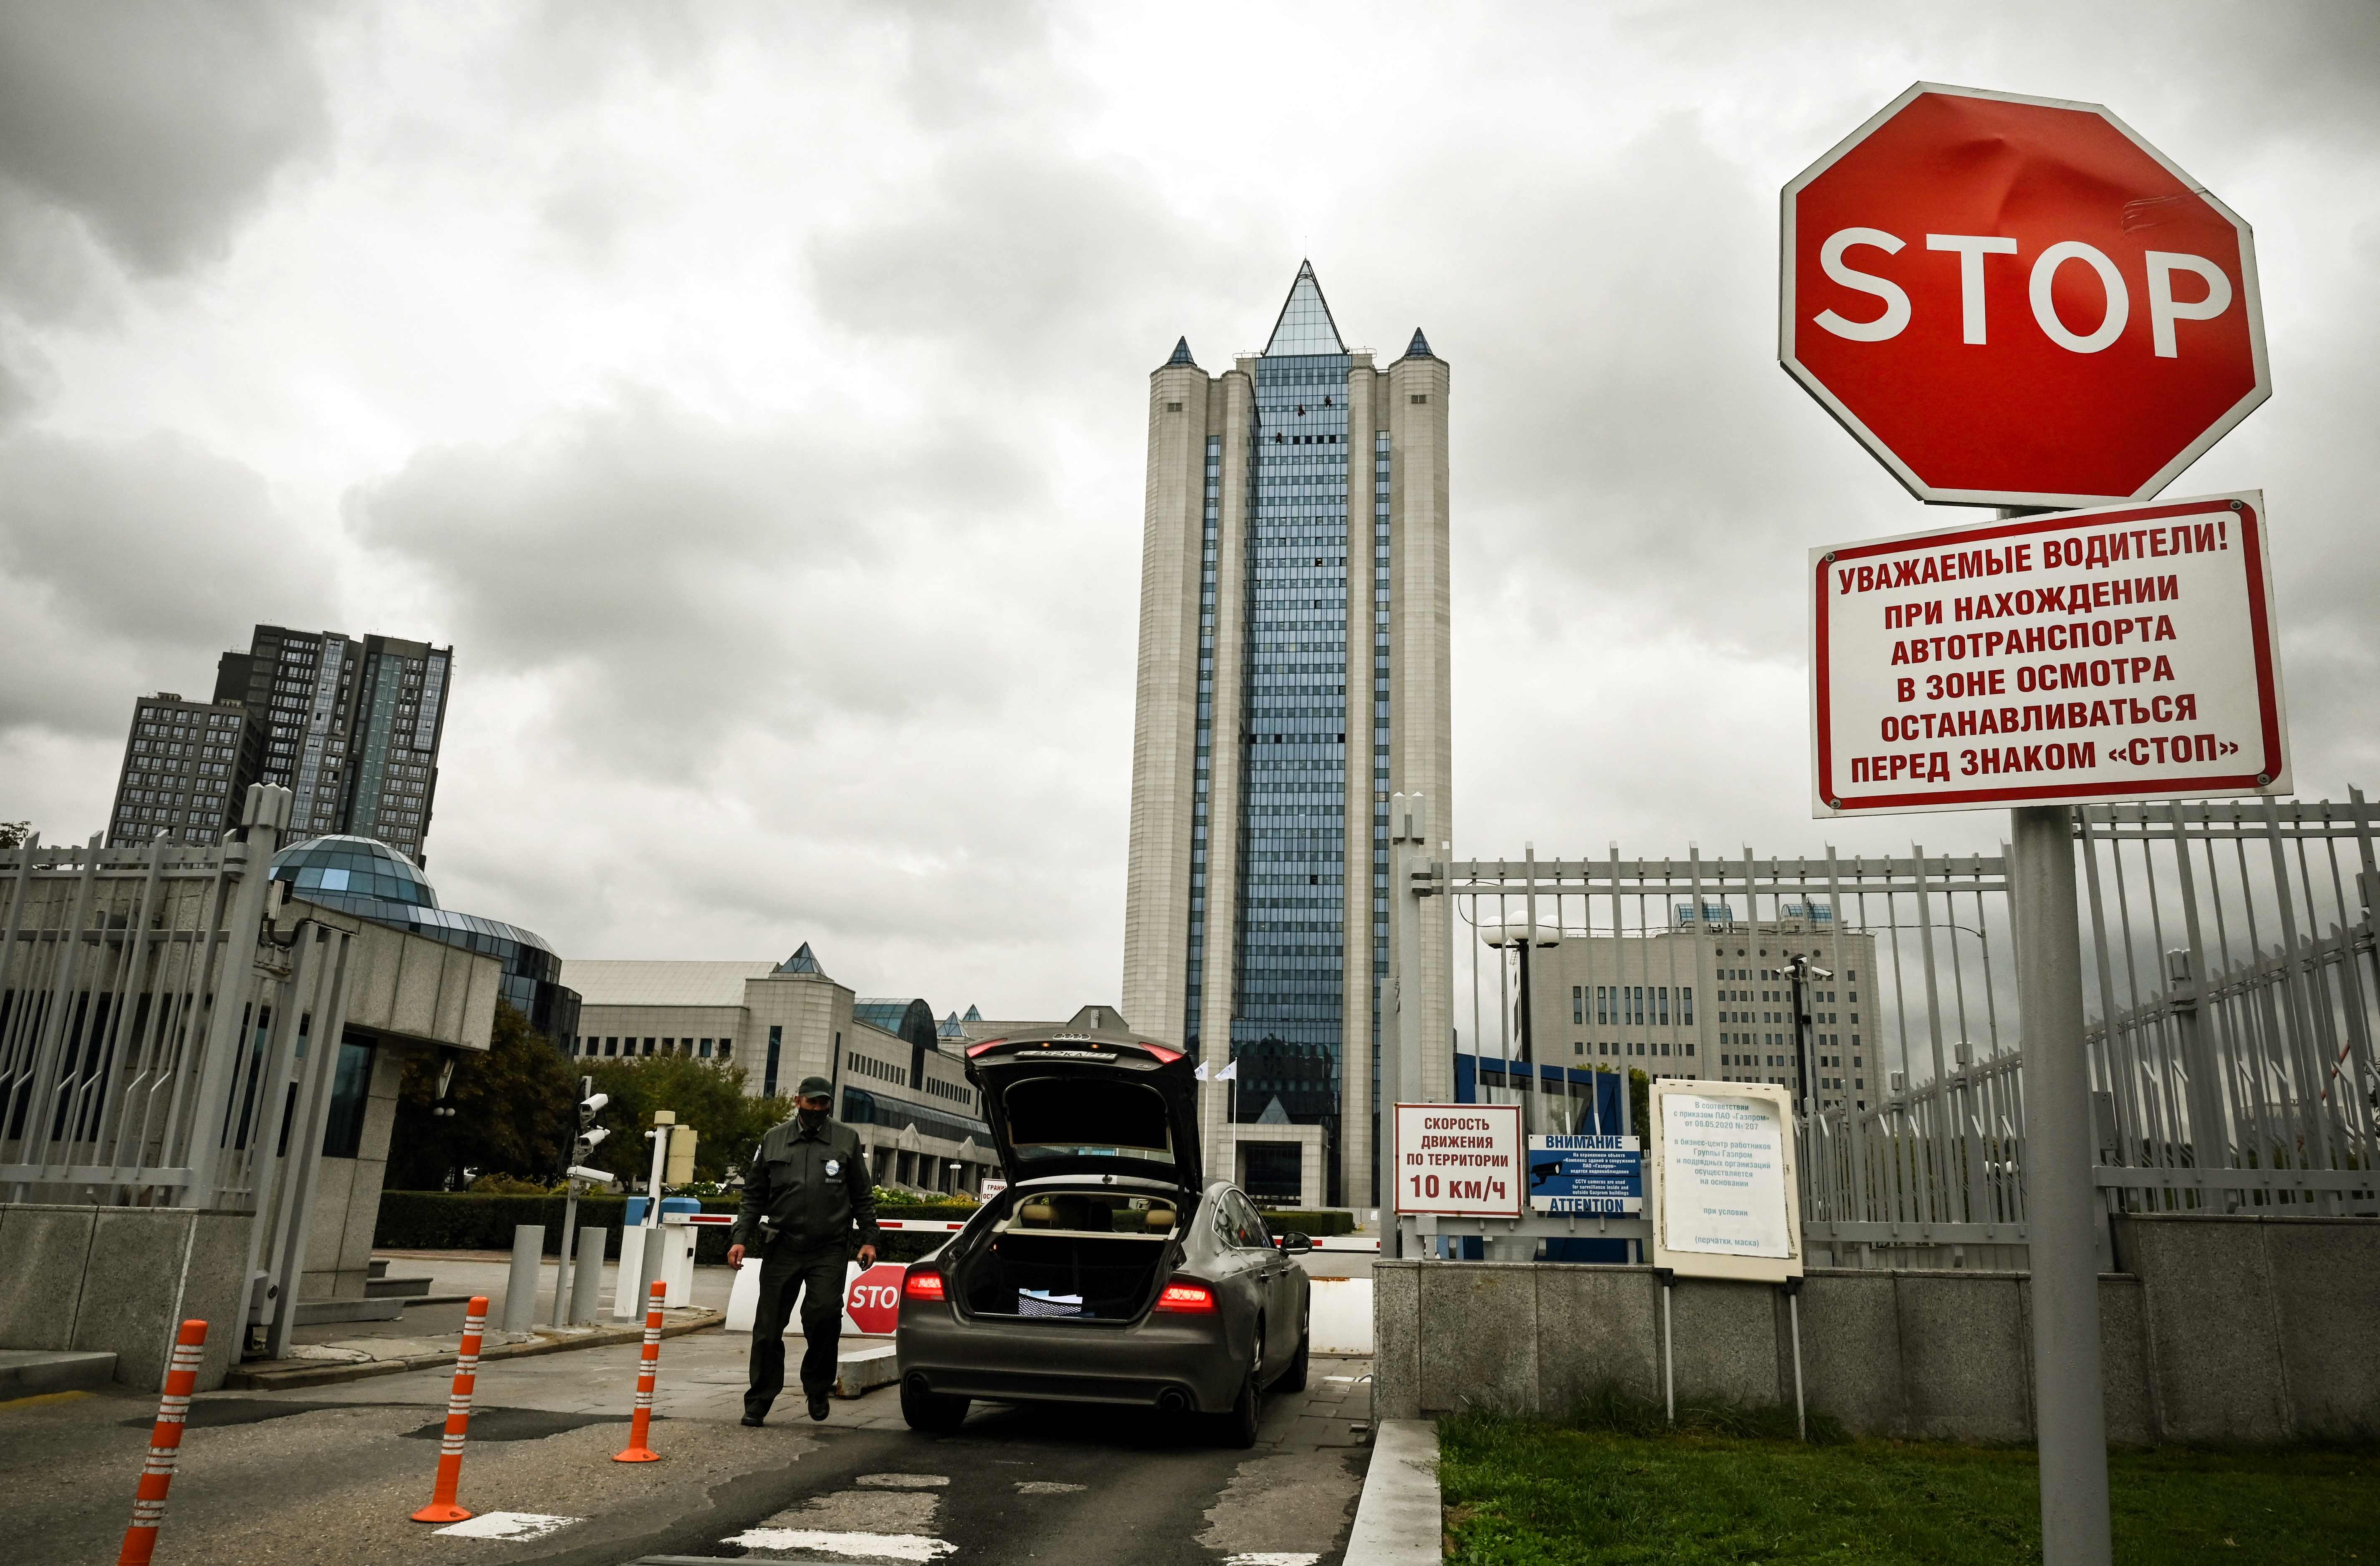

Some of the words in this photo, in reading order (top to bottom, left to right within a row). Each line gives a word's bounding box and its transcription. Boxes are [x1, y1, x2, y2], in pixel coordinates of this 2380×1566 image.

[1813, 227, 2232, 359] STOP
[1838, 543, 2032, 594] УВАЖАЕМЫЕ
[2044, 522, 2227, 569] ВОДИТЕЛИ!
[1885, 598, 1942, 630] ПРИ
[1955, 574, 2179, 622] НАХОЖДЕНИИ
[1891, 614, 2176, 666] АВТОТРАНСПОРТА
[1898, 677, 1915, 702] В
[1926, 669, 2004, 701] ЗОНЕ
[2017, 655, 2175, 694] ОСМОТРА
[1881, 693, 2197, 743] ОСТАНАВЛИВАТЬСЯ
[1852, 750, 1950, 783] ПЕРЕД
[1961, 742, 2096, 775] ЗНАКОМ
[2108, 733, 2239, 766] «СТОП»
[1424, 1117, 1490, 1130] СКОРОСТЬ
[1732, 1113, 1770, 1122] «Газпром»
[1421, 1135, 1493, 1149] ДВИЖЕНИЯ
[1546, 1135, 1622, 1149] ВНИМАНИЕ
[1681, 1138, 1728, 1147] бизнес-центр
[1730, 1142, 1771, 1150] работников
[1407, 1153, 1423, 1165] ПО
[1428, 1154, 1508, 1167] ТЕРРИТОРИИ
[1694, 1148, 1720, 1157] Группы
[1722, 1150, 1752, 1159] Газпром
[1725, 1161, 1770, 1169] организаций
[1695, 1168, 1753, 1177] осуществляется
[1410, 1174, 1439, 1198] 10
[1550, 1198, 1624, 1212] ATTENTION
[1695, 1235, 1732, 1245] (перчатки,
[1735, 1239, 1759, 1248] маска)
[850, 1285, 900, 1309] STO
